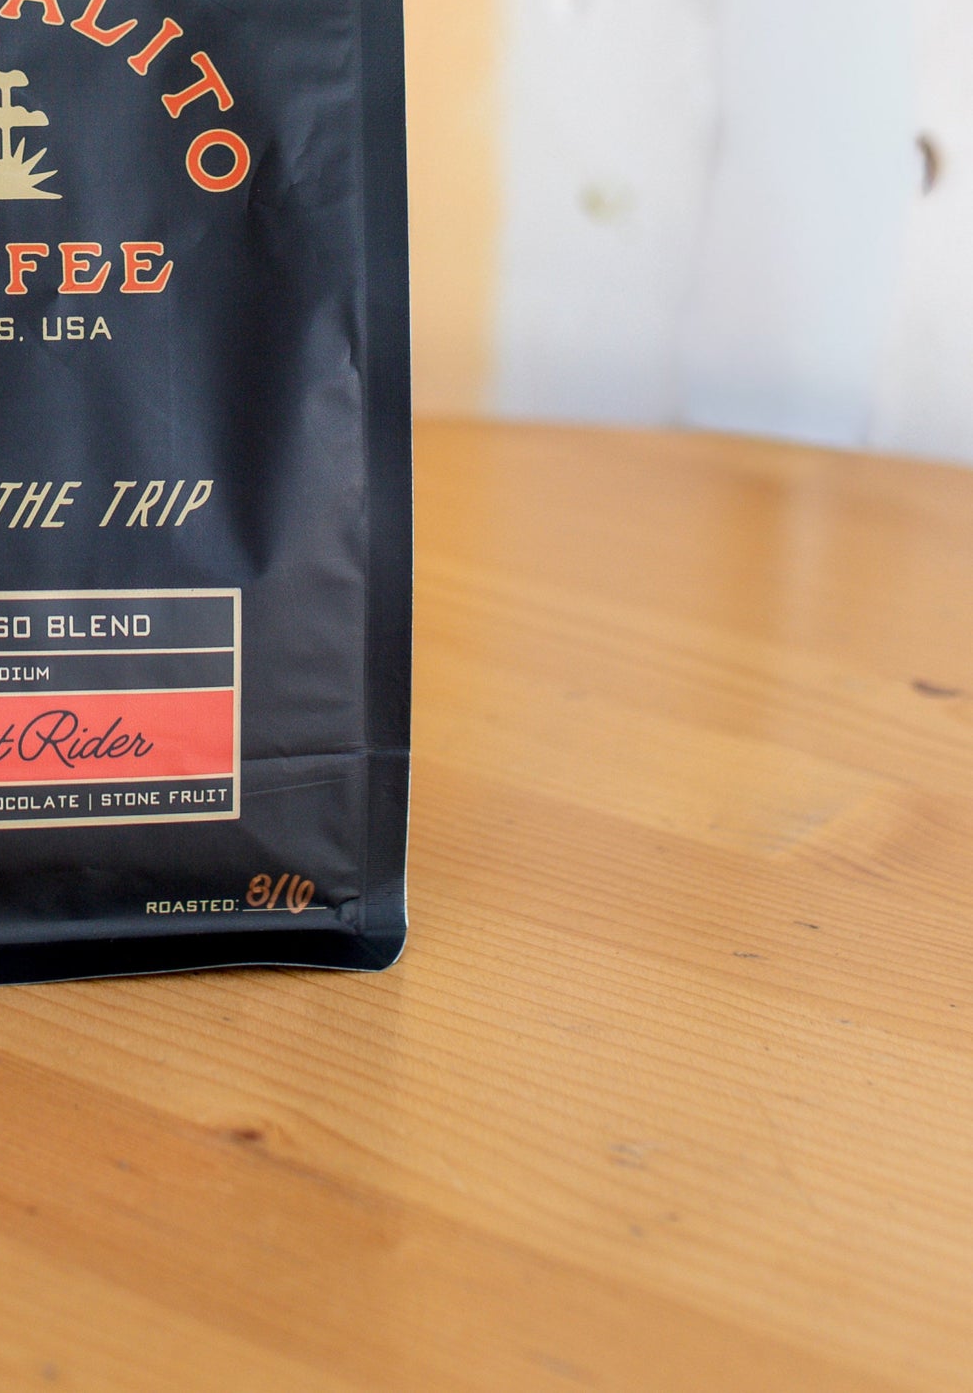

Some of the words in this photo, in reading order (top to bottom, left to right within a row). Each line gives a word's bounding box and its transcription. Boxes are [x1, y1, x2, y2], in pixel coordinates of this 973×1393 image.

[42, 317, 112, 341] USA
[99, 479, 214, 527] TRIP
[47, 614, 152, 637] BLEND
[17, 709, 154, 769] Rider
[100, 791, 161, 807] STONE
[168, 788, 229, 805] FRUIT
[146, 899, 239, 914] ROASTED:
